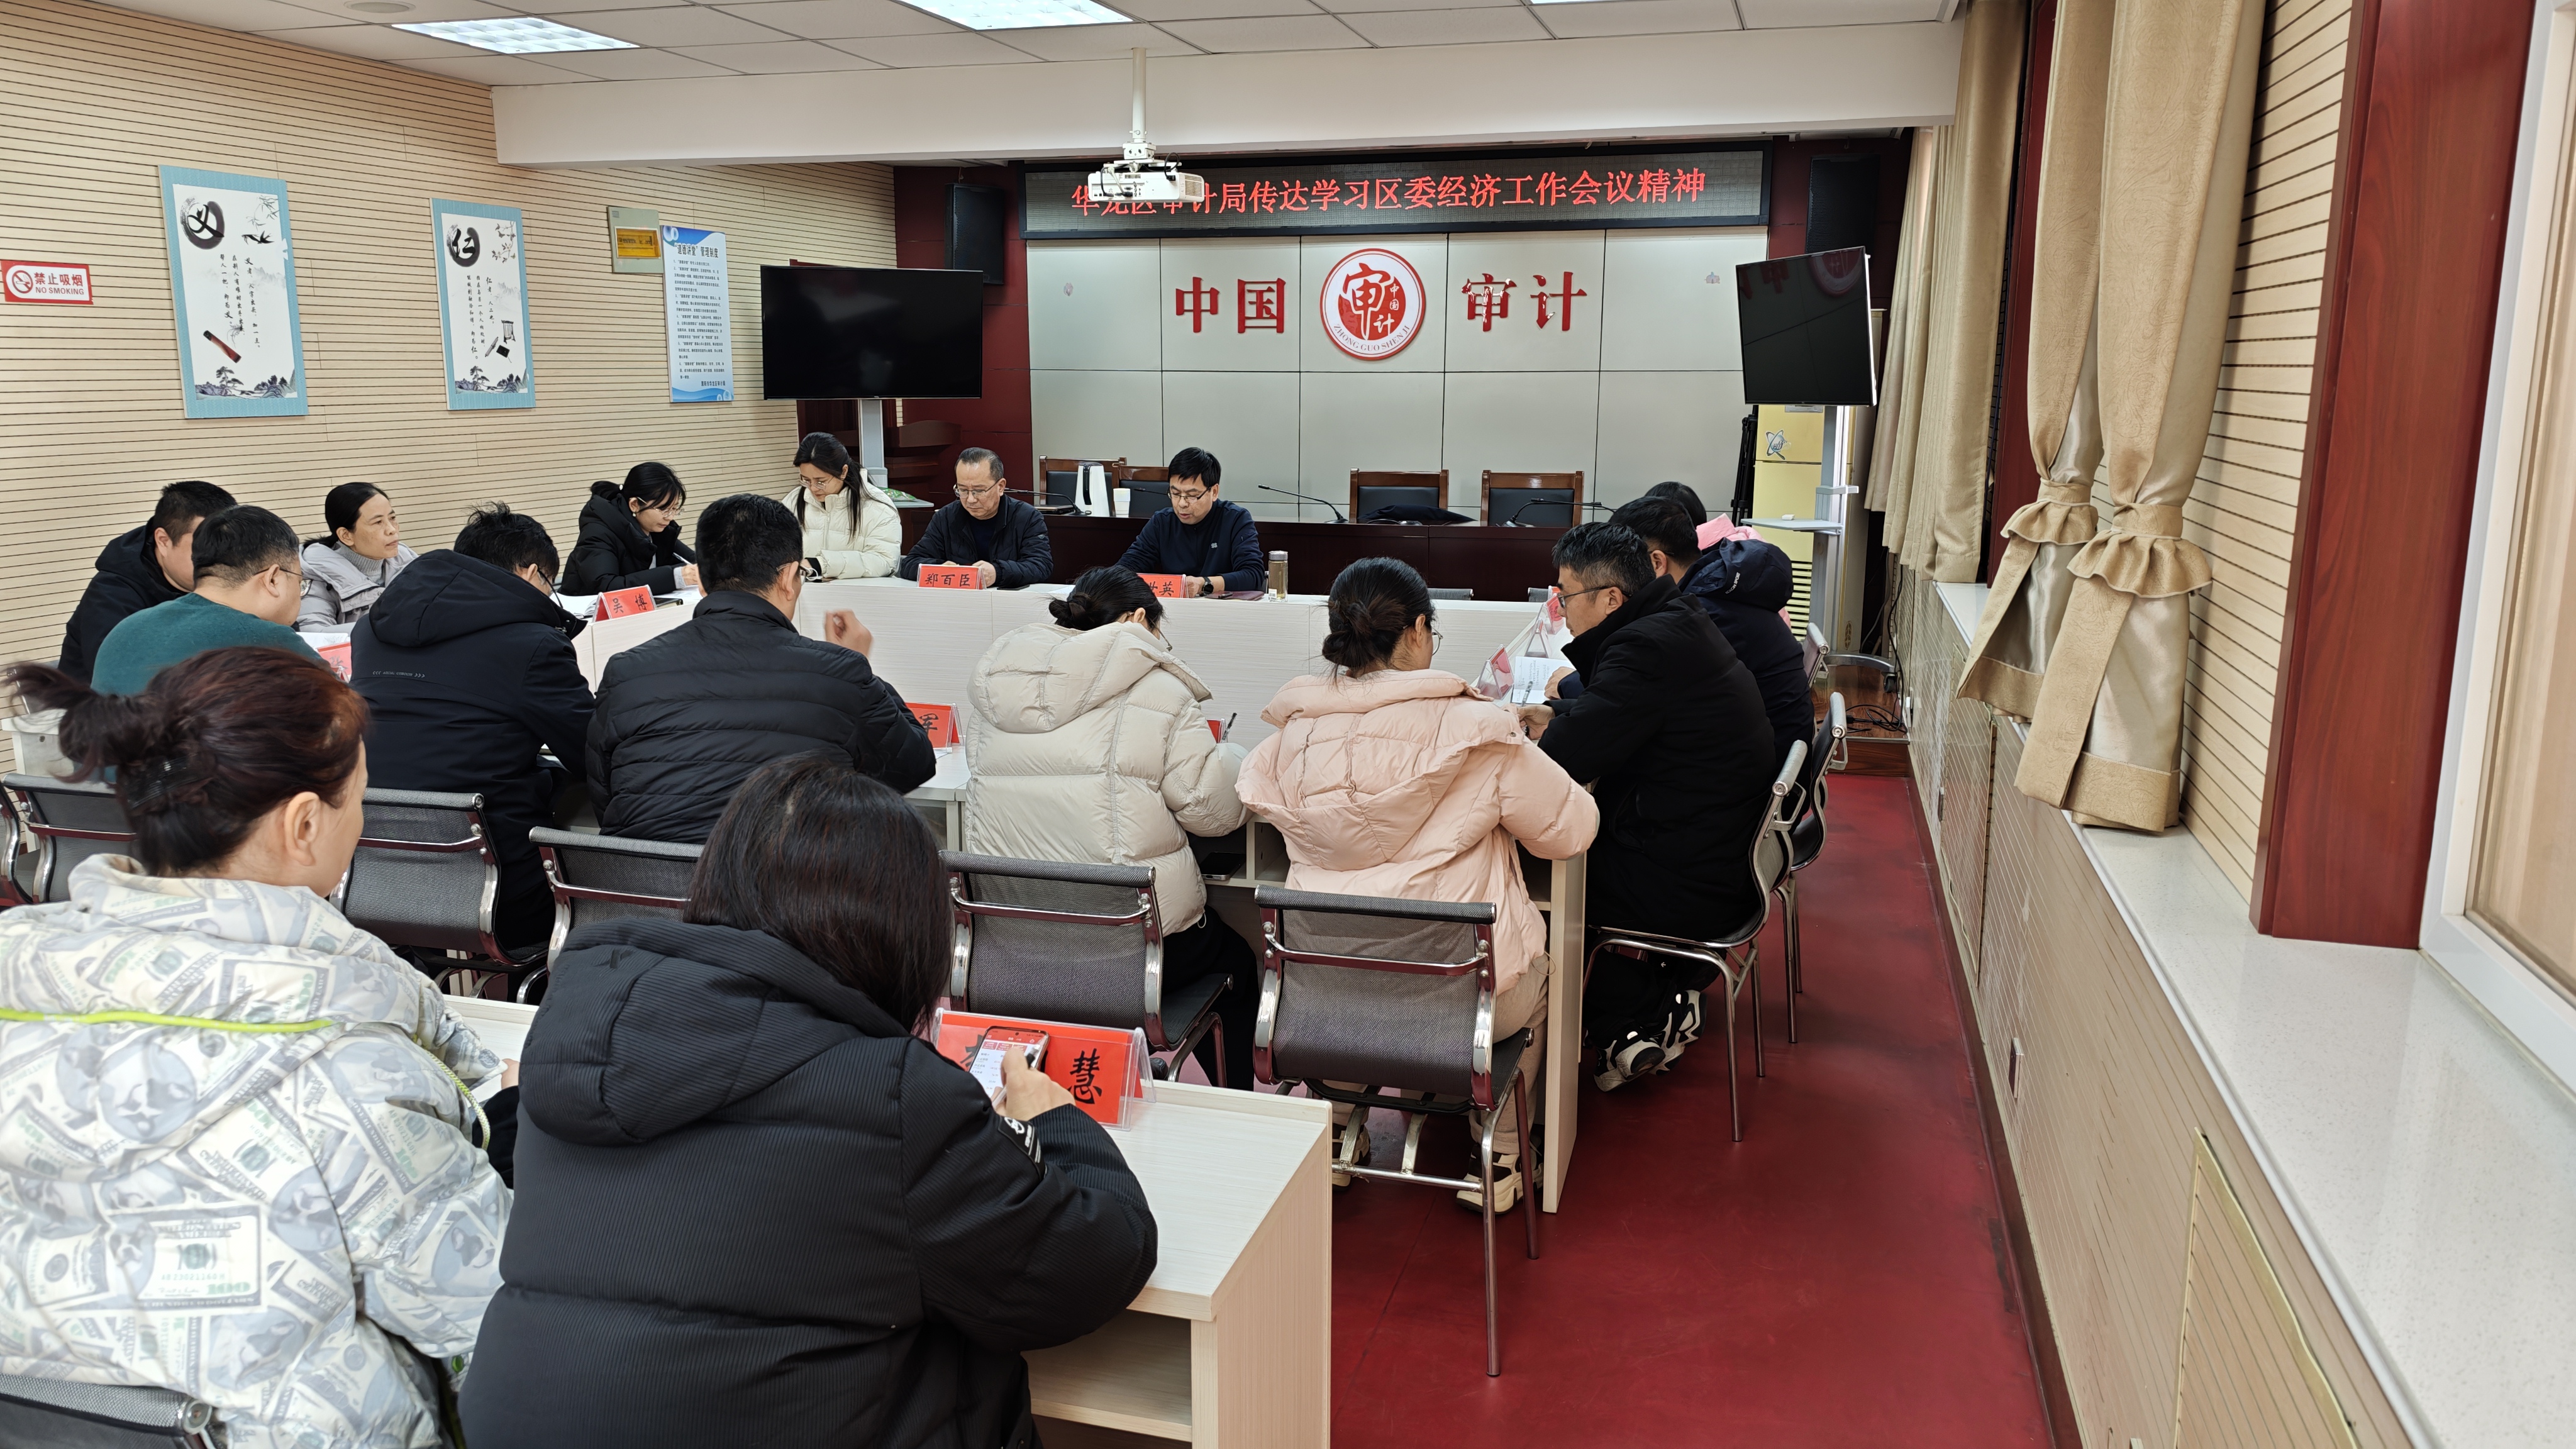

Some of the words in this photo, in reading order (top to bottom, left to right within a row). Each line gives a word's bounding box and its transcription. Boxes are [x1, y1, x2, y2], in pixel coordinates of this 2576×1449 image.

[187, 204, 225, 238] 义
[452, 228, 477, 258] 仁
[700, 246, 719, 258] 管理制度
[34, 272, 84, 287] 禁止吸烟
[48, 287, 84, 295] SMOKING
[1175, 276, 1286, 333] 中国
[1462, 273, 1587, 332] 审计
[1333, 323, 1359, 348] ZHONG
[1381, 333, 1404, 350] SHEN
[925, 572, 970, 587] 郑百臣
[612, 593, 648, 614] 吴博
